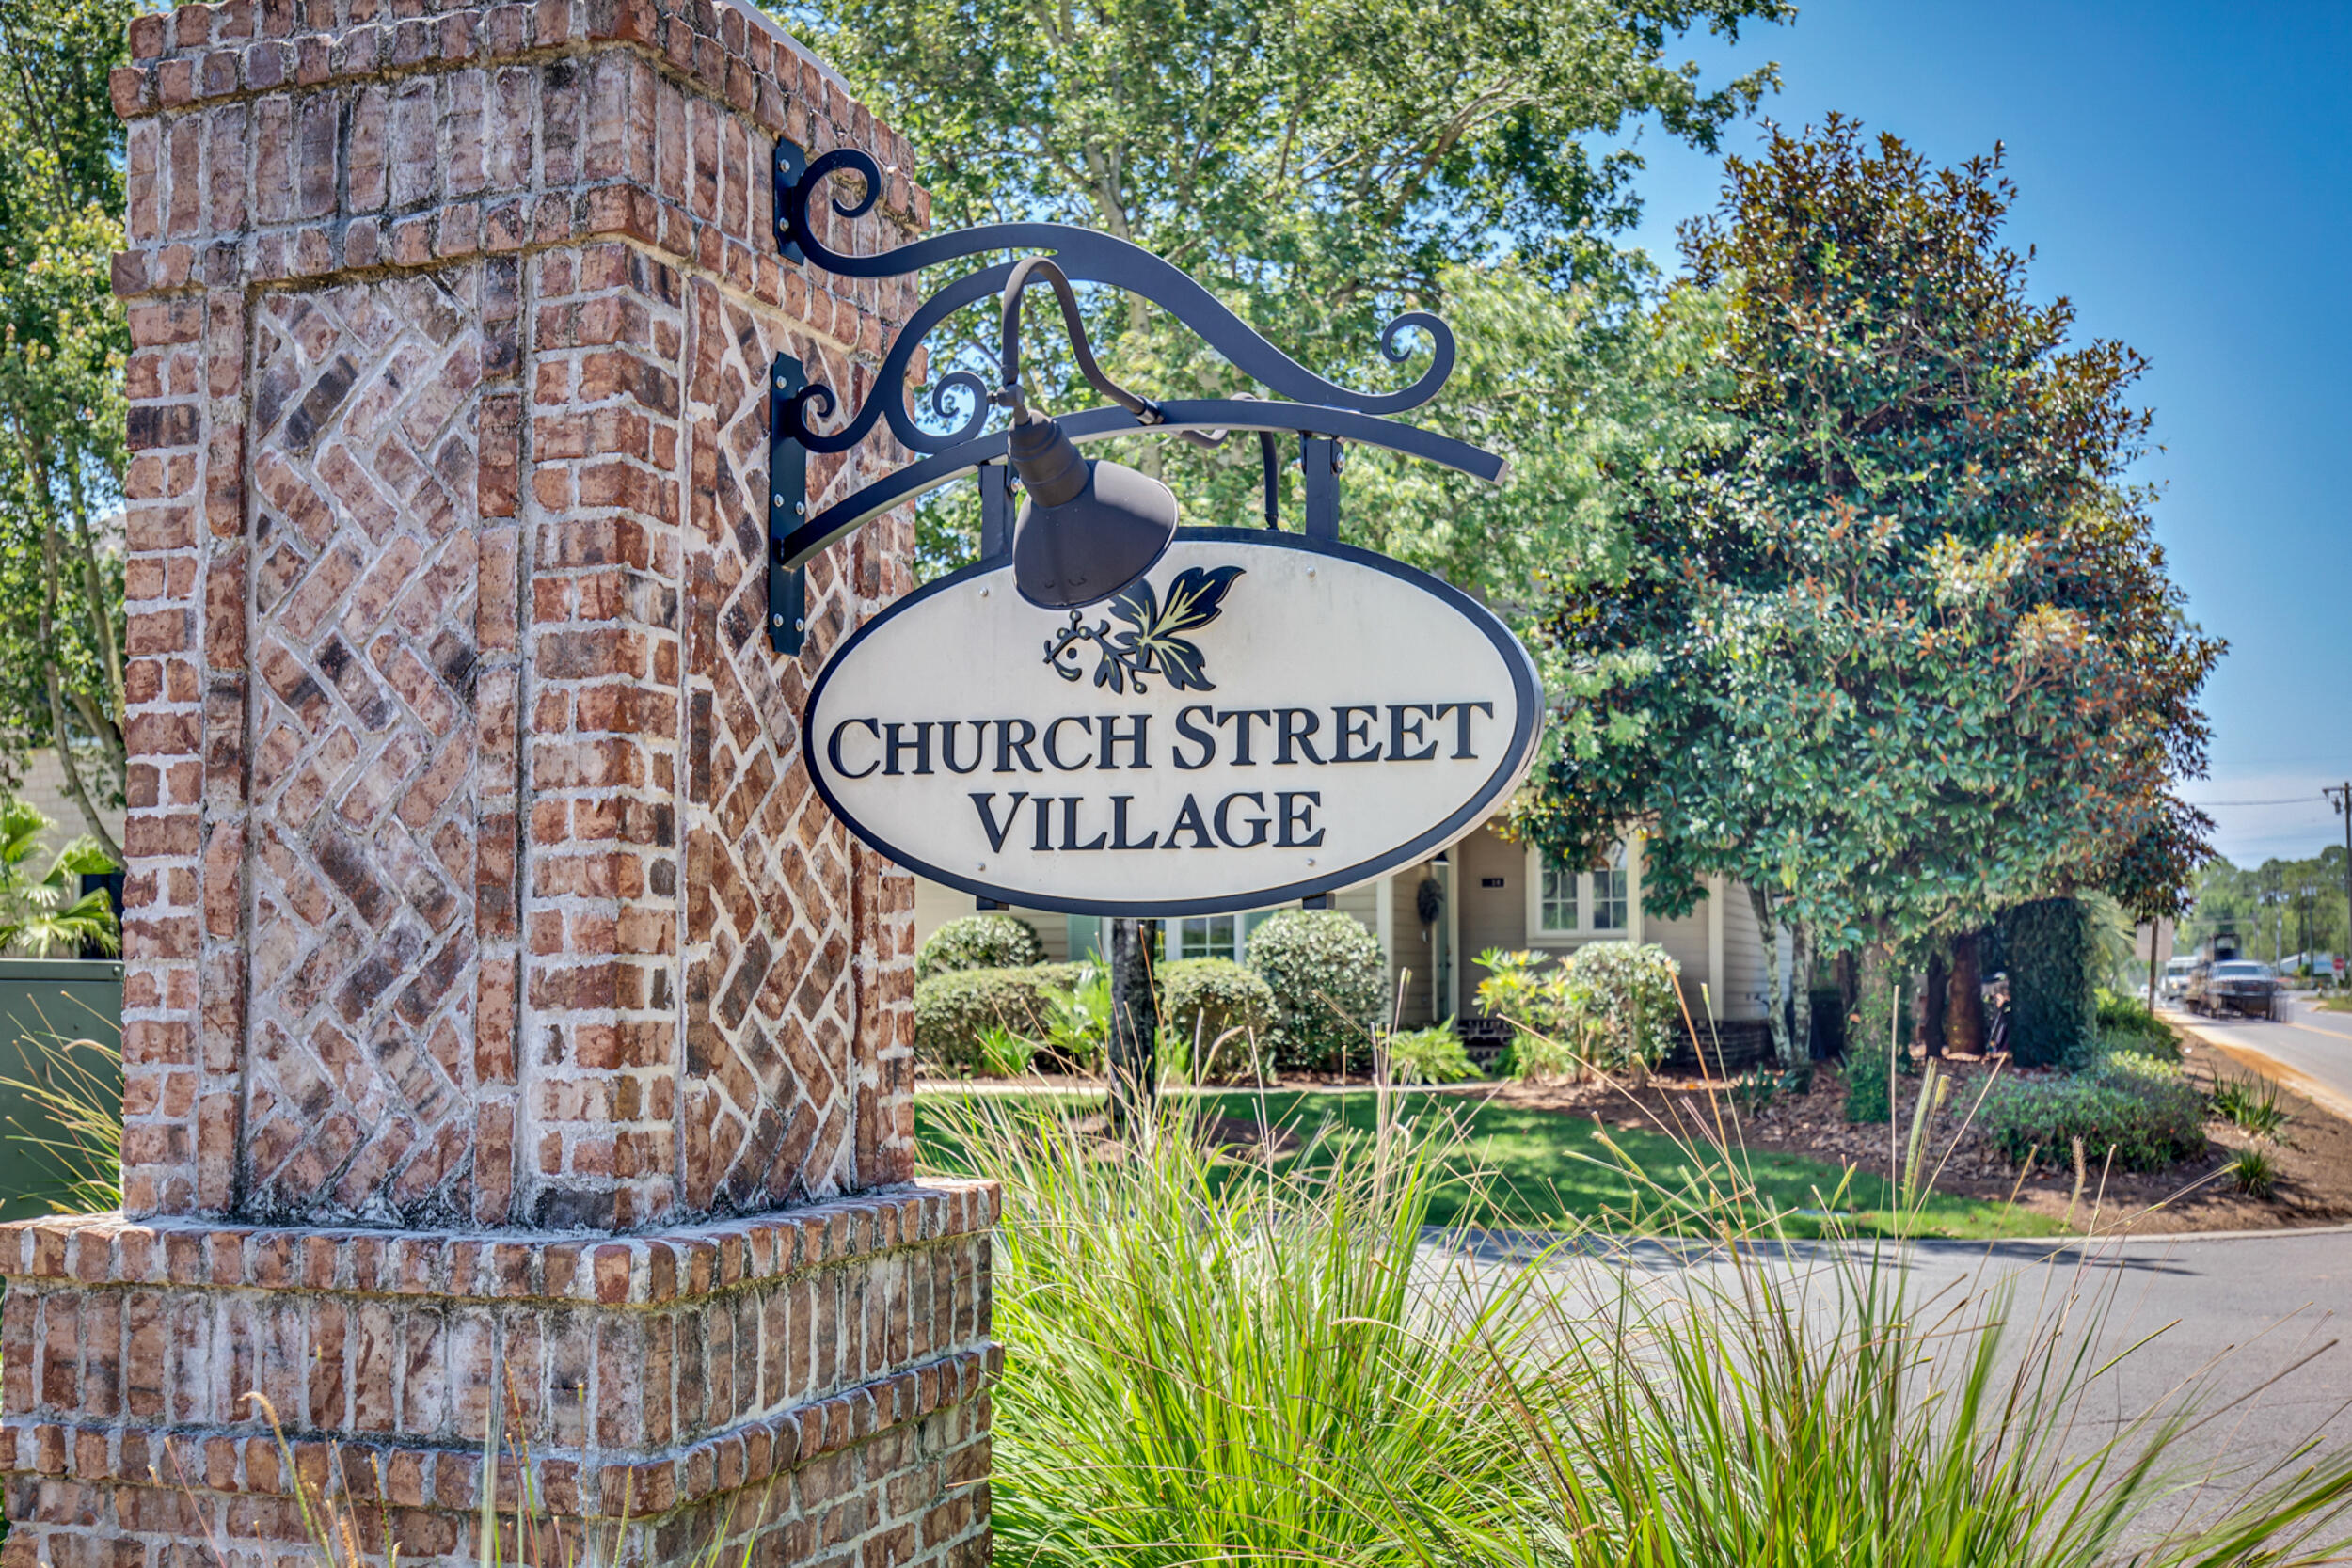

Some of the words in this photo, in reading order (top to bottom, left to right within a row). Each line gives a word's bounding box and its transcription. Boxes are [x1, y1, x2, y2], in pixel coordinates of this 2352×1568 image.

[827, 715, 1152, 779] CHURCH
[1172, 701, 1494, 770] STREET
[968, 791, 1325, 854] VILLAGE
